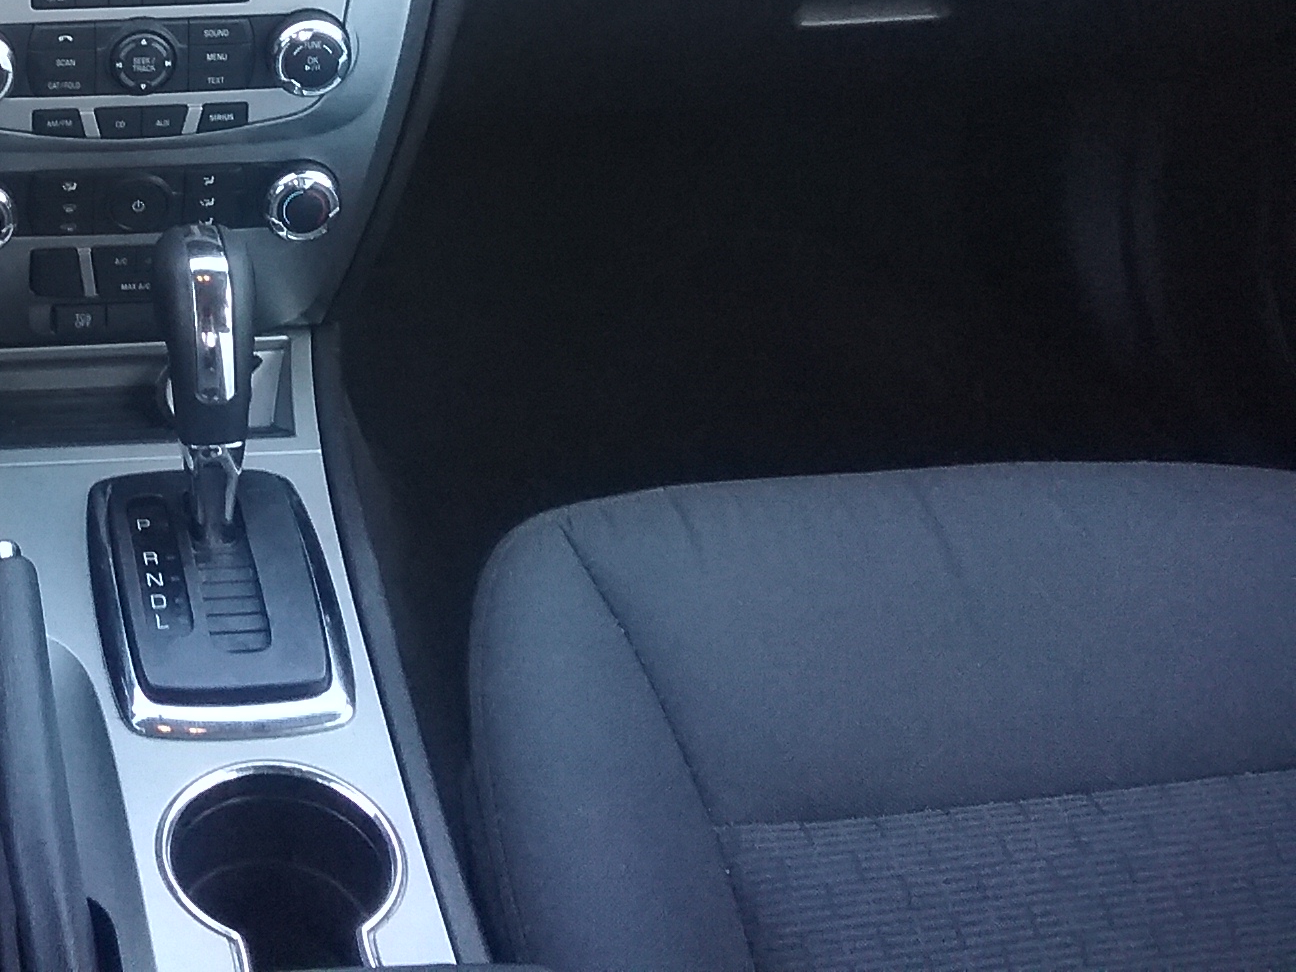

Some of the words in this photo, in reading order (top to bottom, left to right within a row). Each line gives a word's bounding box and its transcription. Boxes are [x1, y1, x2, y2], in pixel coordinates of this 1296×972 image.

[203, 28, 230, 38] SOUND
[206, 53, 228, 62] MENU
[55, 58, 77, 68] SCAN
[207, 76, 225, 85] TEXT
[208, 112, 236, 122] SIRIUS
[120, 283, 137, 291] MAX
[135, 518, 151, 531] P
[143, 551, 159, 566] R
[146, 572, 164, 587] N
[150, 593, 168, 610] D
[155, 613, 170, 630] L
